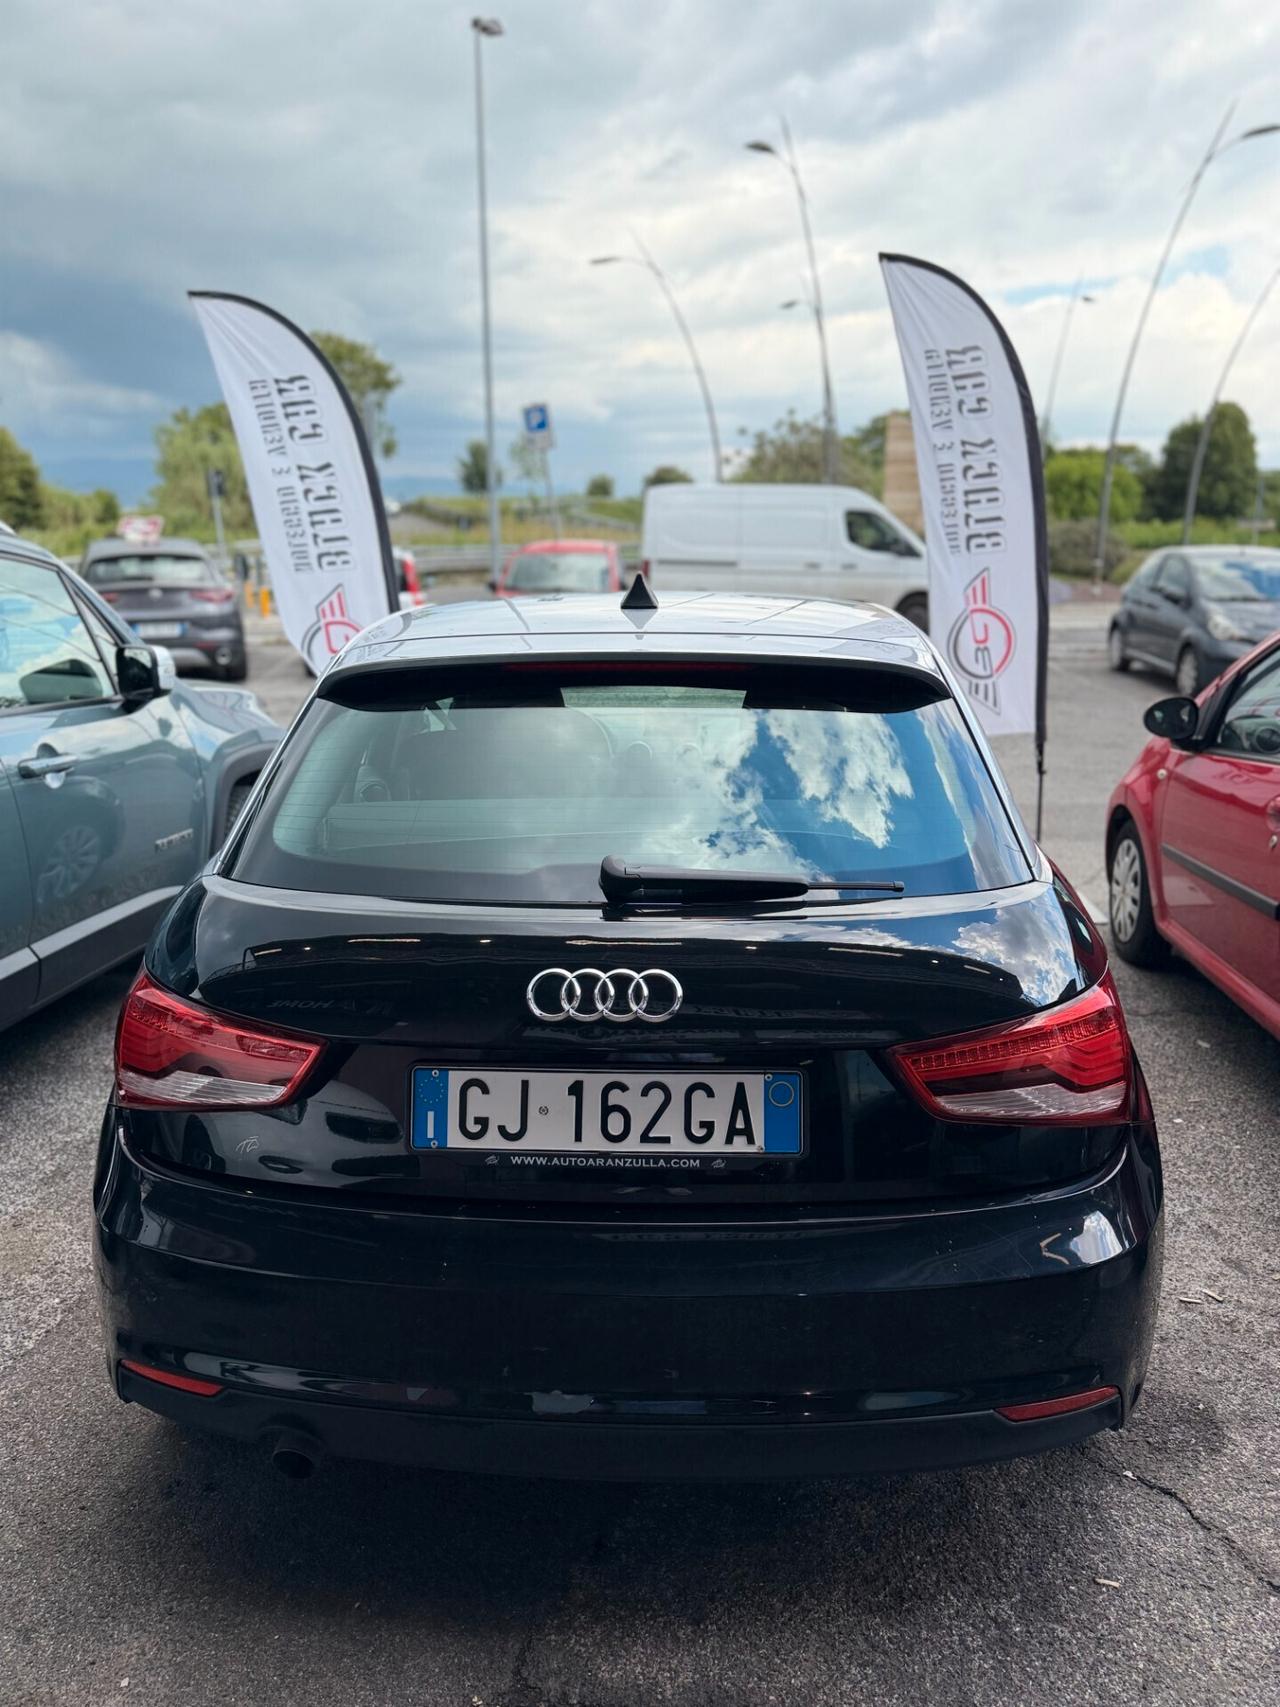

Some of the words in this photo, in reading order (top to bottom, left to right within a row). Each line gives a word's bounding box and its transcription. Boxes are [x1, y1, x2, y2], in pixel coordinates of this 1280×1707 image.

[458, 1077, 530, 1142] GJ
[567, 1079, 756, 1145] 162GA
[510, 1155, 700, 1168] WWW.AUTOARANZULLA.COM
